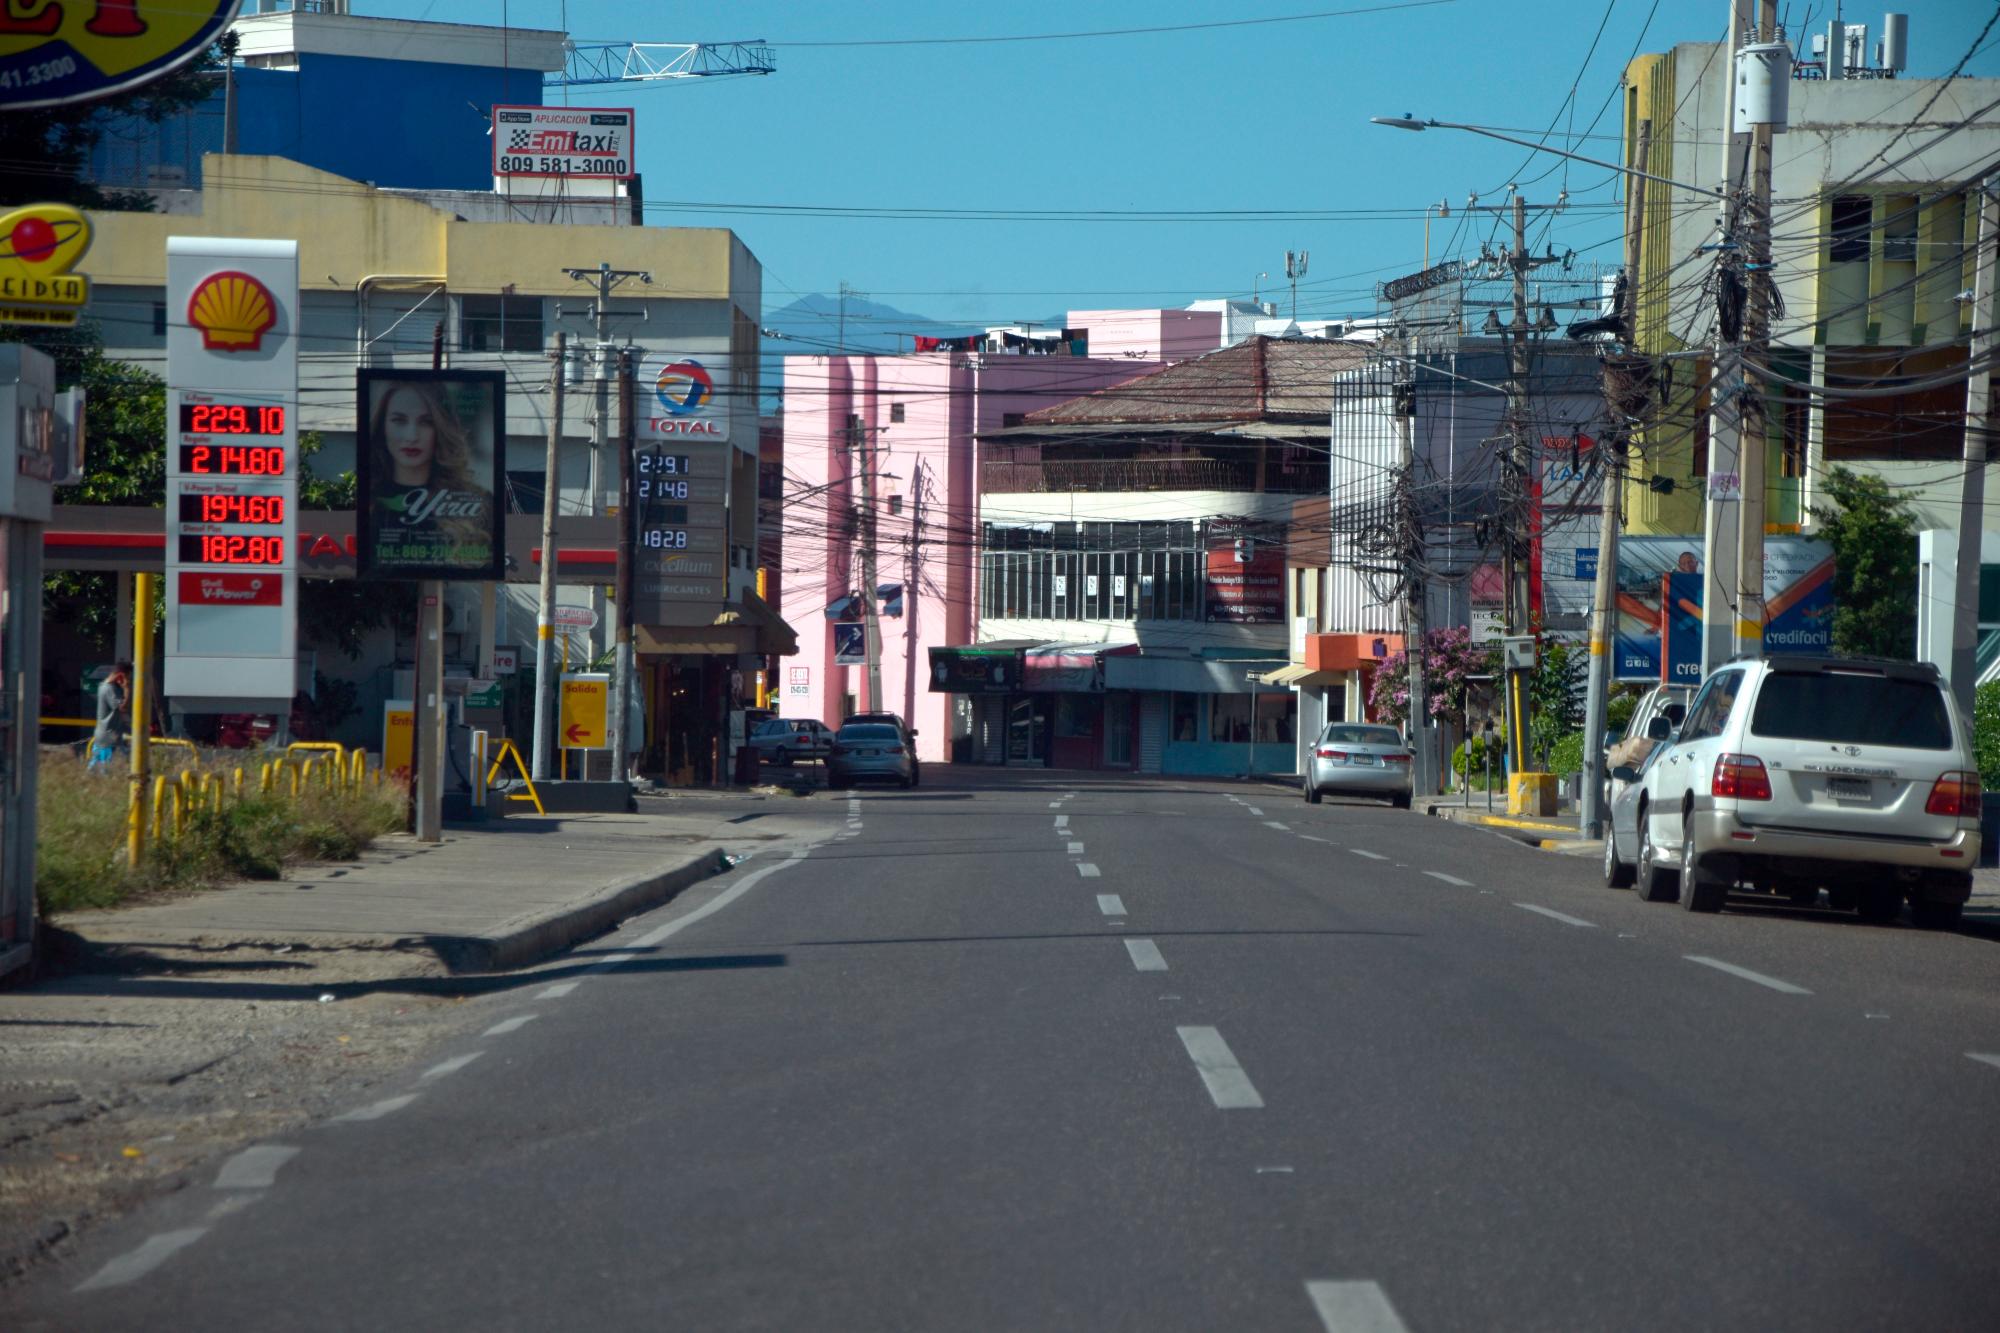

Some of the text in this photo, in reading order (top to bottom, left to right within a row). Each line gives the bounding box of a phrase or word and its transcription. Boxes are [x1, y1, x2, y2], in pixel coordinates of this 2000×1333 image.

[527, 129, 614, 152] Emitaxi
[500, 156, 627, 174] 809 581-3000
[648, 417, 721, 435] TOTAL
[639, 480, 688, 499] 214.8
[202, 495, 285, 524] 194.60
[644, 530, 687, 549] 182.8
[201, 535, 284, 565] 182.80
[202, 588, 257, 599] V-Power
[643, 584, 711, 595] LUBRICANTES
[1676, 662, 1703, 676] cre
[565, 683, 598, 694] Salida
